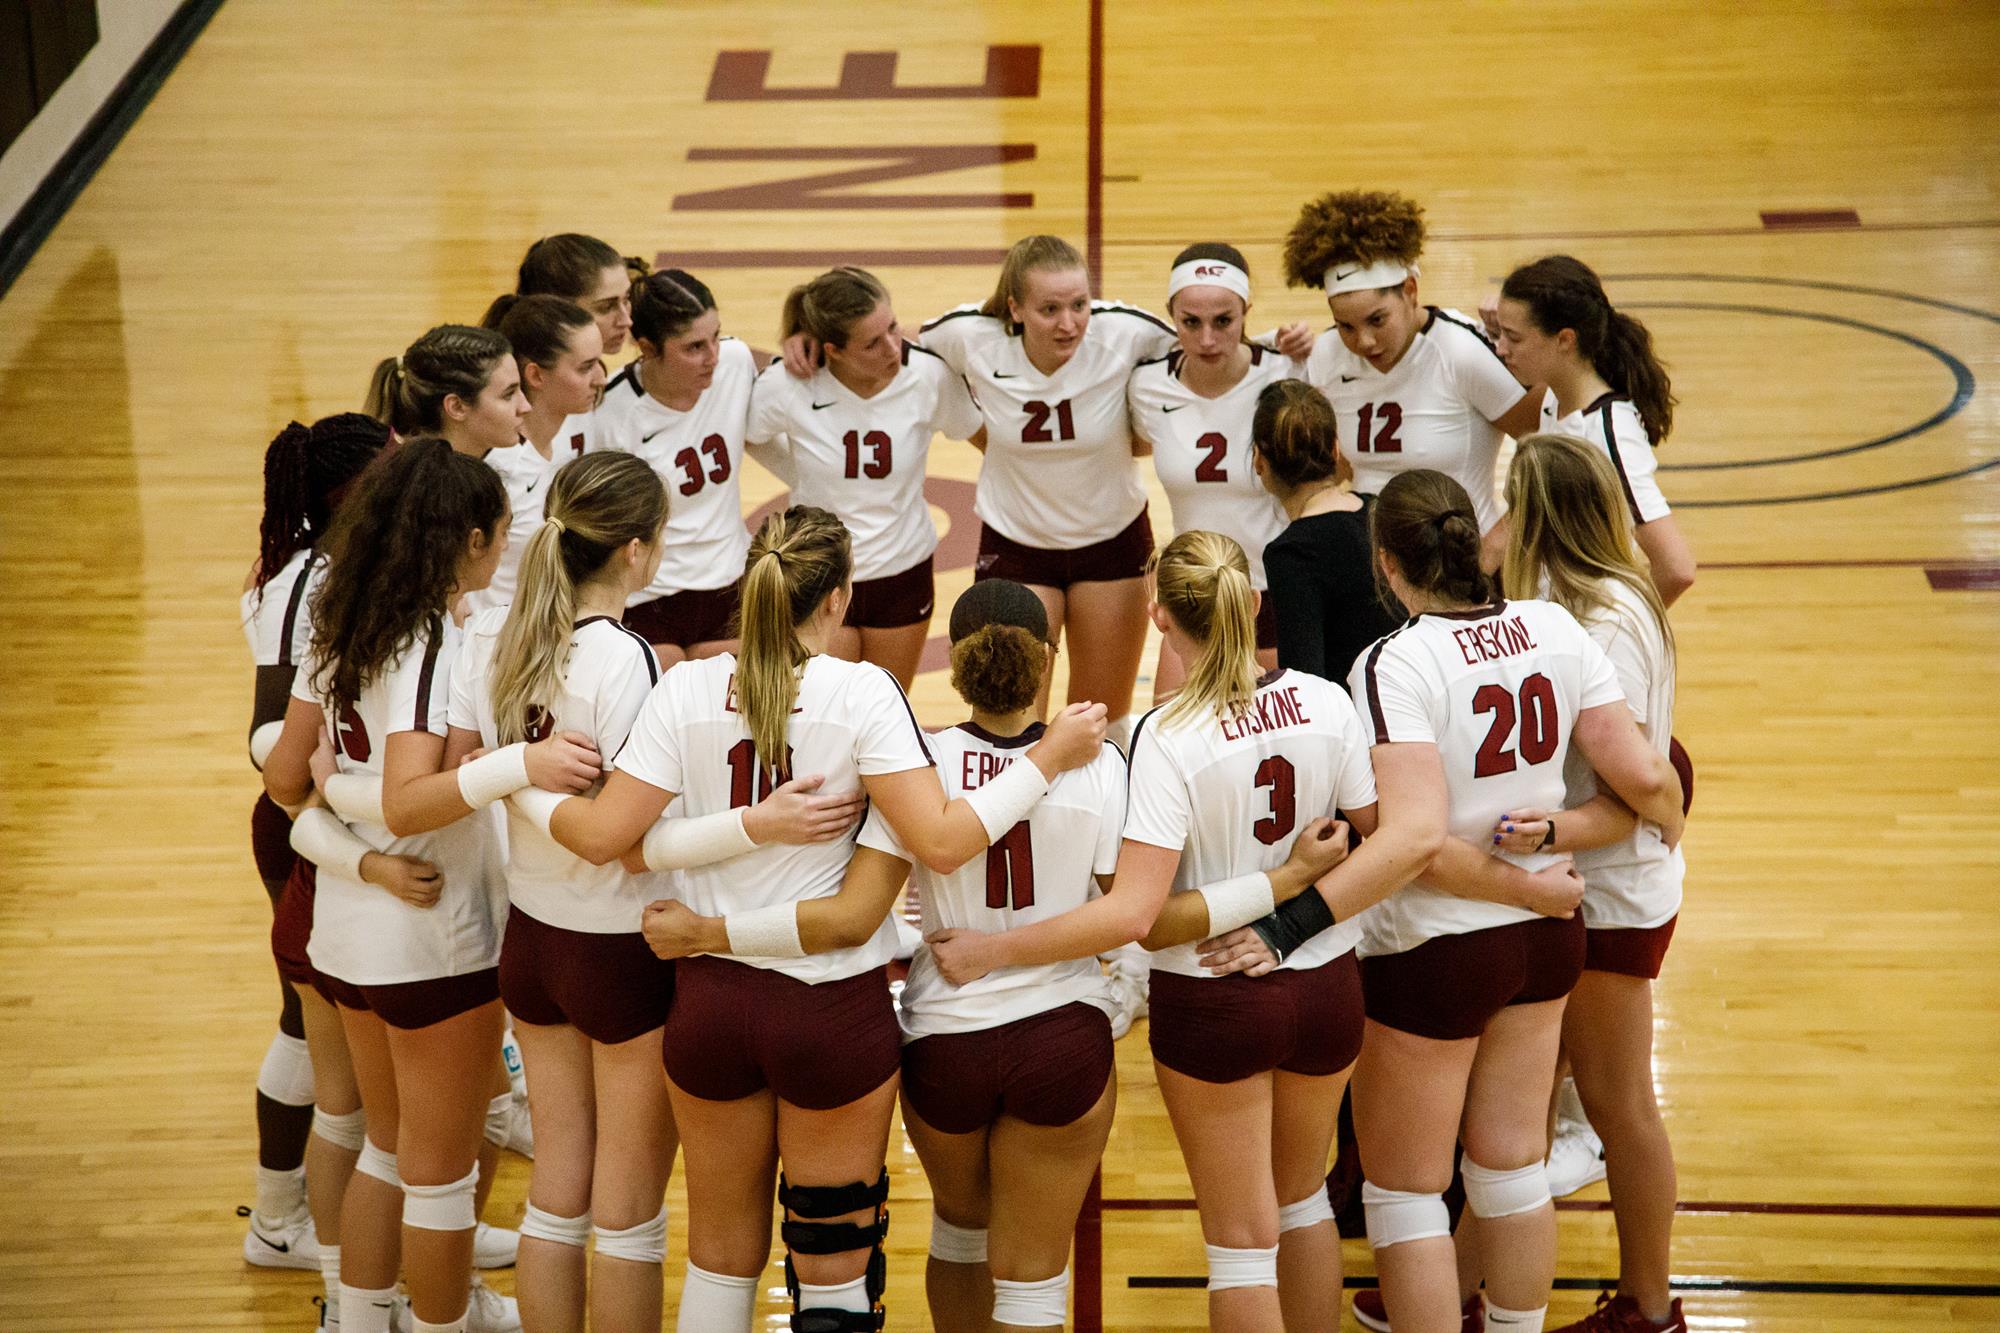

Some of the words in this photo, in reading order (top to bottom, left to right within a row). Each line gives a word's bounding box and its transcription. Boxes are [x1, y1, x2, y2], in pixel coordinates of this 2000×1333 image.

[1021, 400, 1076, 443] 21
[1357, 402, 1403, 453] 12
[674, 433, 732, 497] 33
[842, 430, 892, 479] 13
[1195, 432, 1229, 482] 2
[1452, 615, 1538, 665] ERSKINE
[1472, 672, 1559, 779] 20
[1254, 755, 1295, 845] 3
[986, 819, 1035, 911] 11
